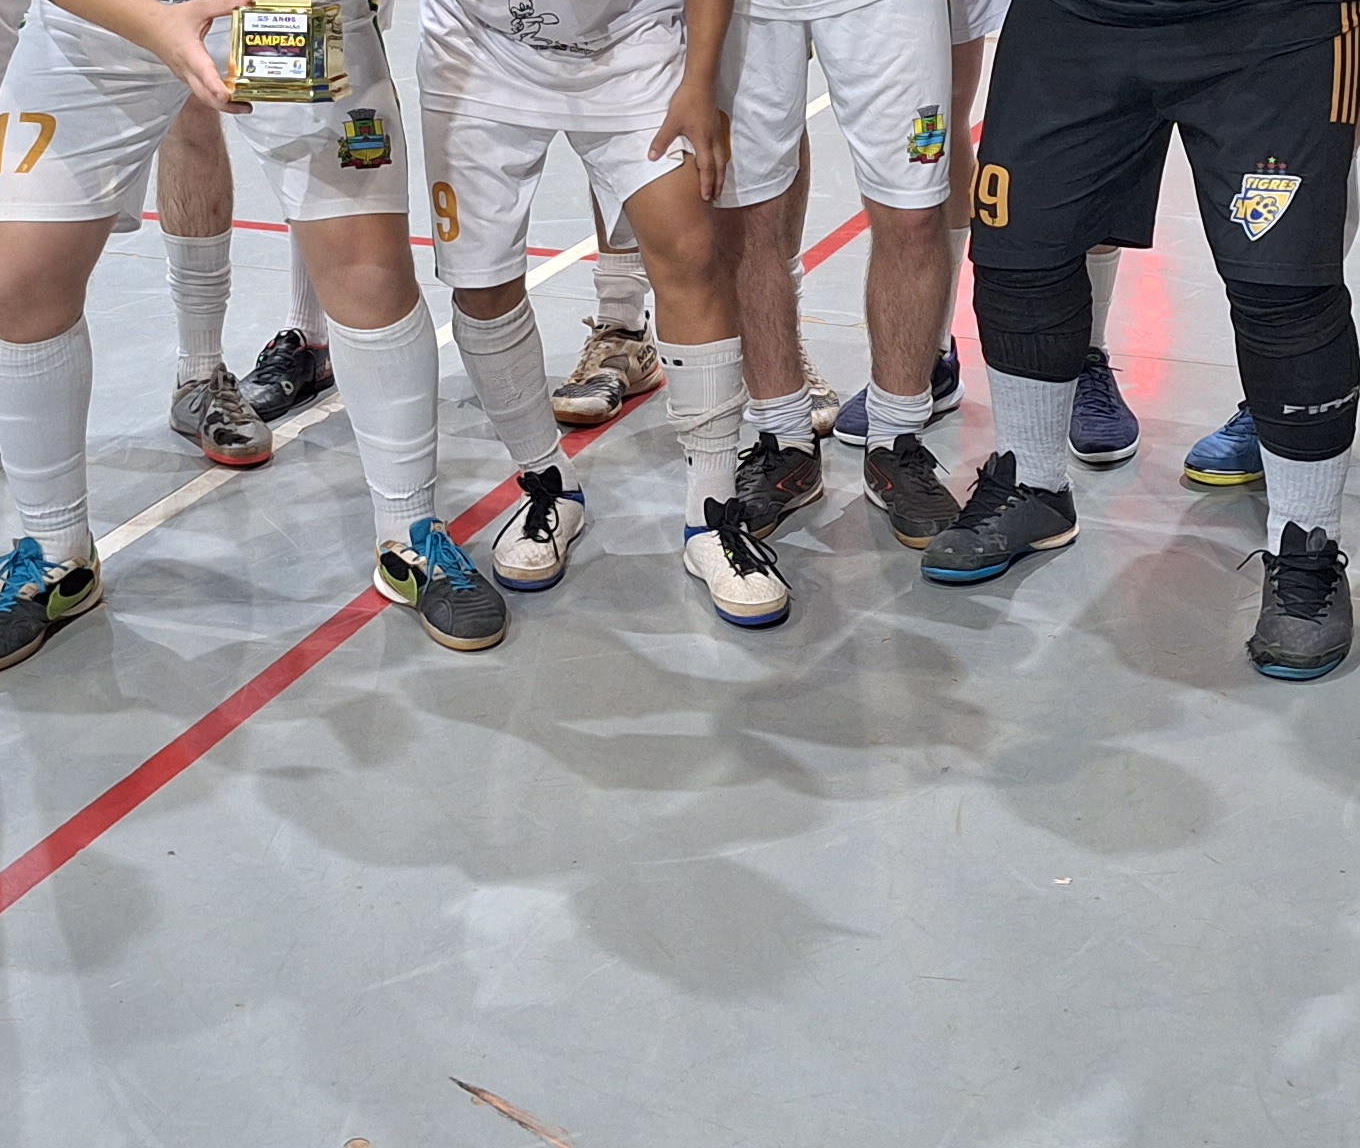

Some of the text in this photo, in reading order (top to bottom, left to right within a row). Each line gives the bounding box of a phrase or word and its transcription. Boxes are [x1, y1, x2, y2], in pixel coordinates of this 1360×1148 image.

[245, 34, 307, 48] CAMPEÃO
[1245, 177, 1297, 191] TIGRES
[431, 181, 460, 243] 9
